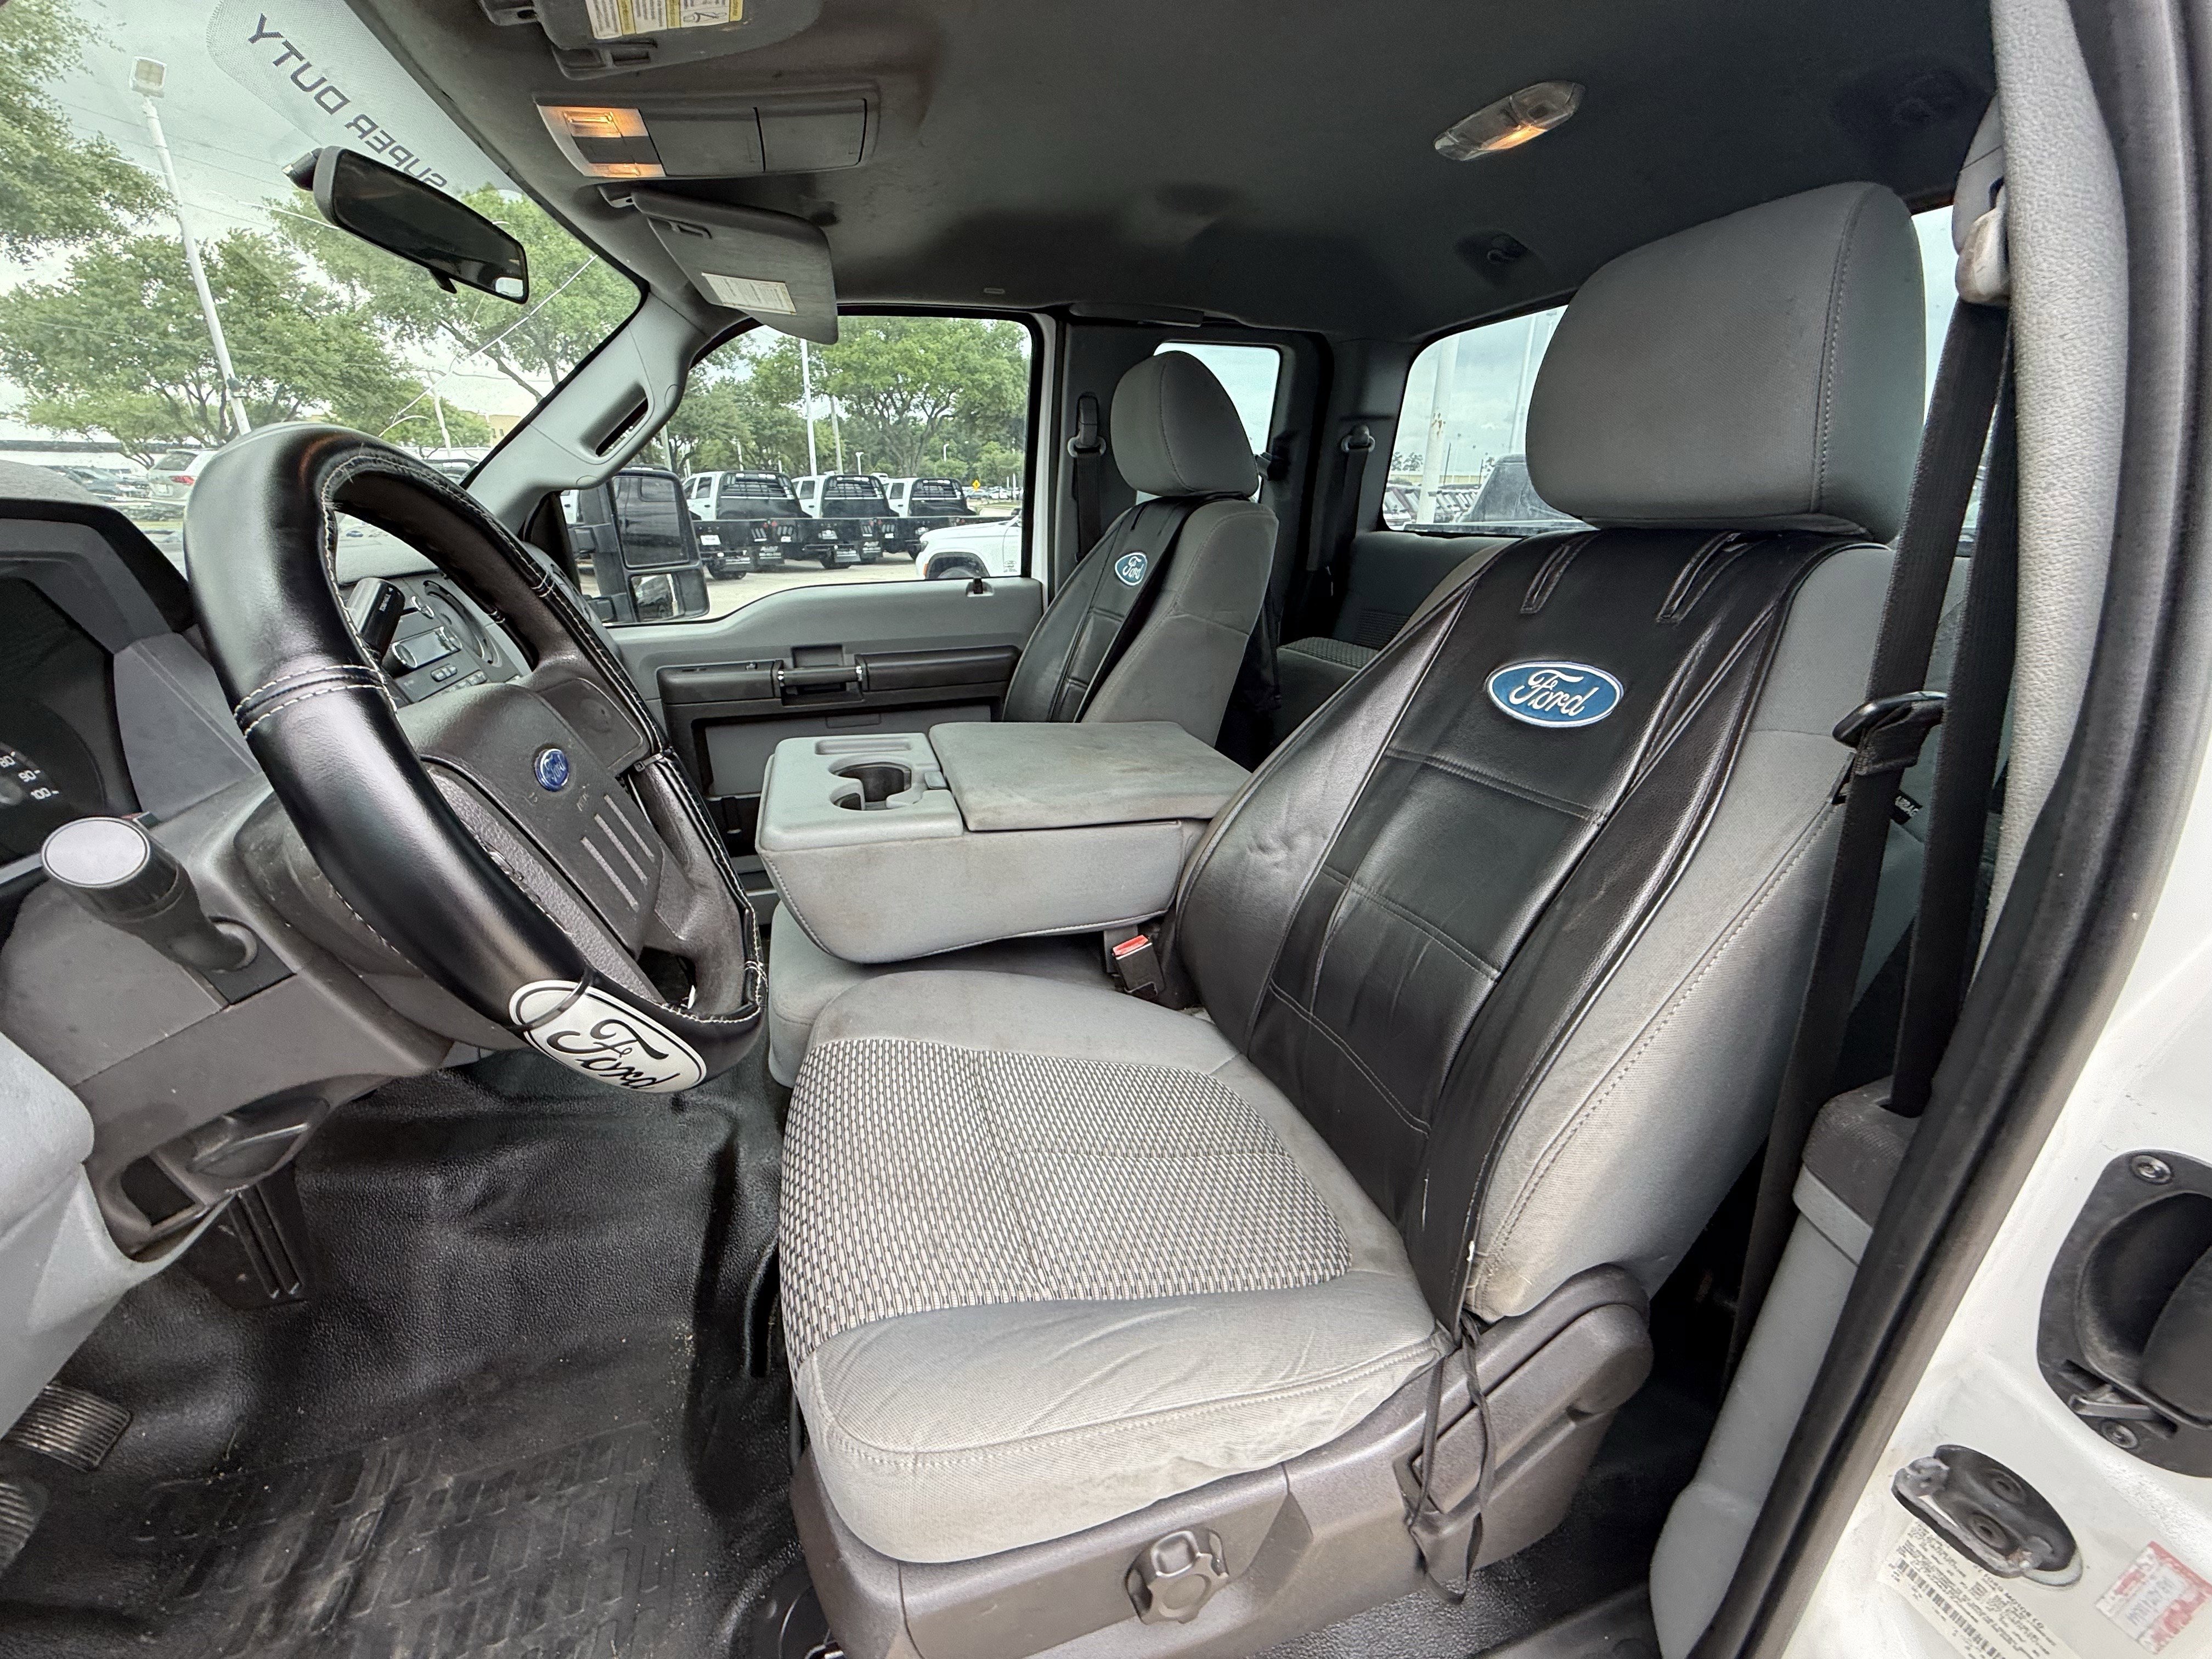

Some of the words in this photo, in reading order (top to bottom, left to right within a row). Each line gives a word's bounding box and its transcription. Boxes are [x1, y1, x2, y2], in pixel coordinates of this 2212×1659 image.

[1122, 556, 1144, 580] Ford
[1509, 669, 1599, 716] Ford
[18, 770, 37, 782] 90
[543, 754, 566, 784] Ford
[30, 787, 52, 800] 100
[546, 1019, 681, 1090] Ford
